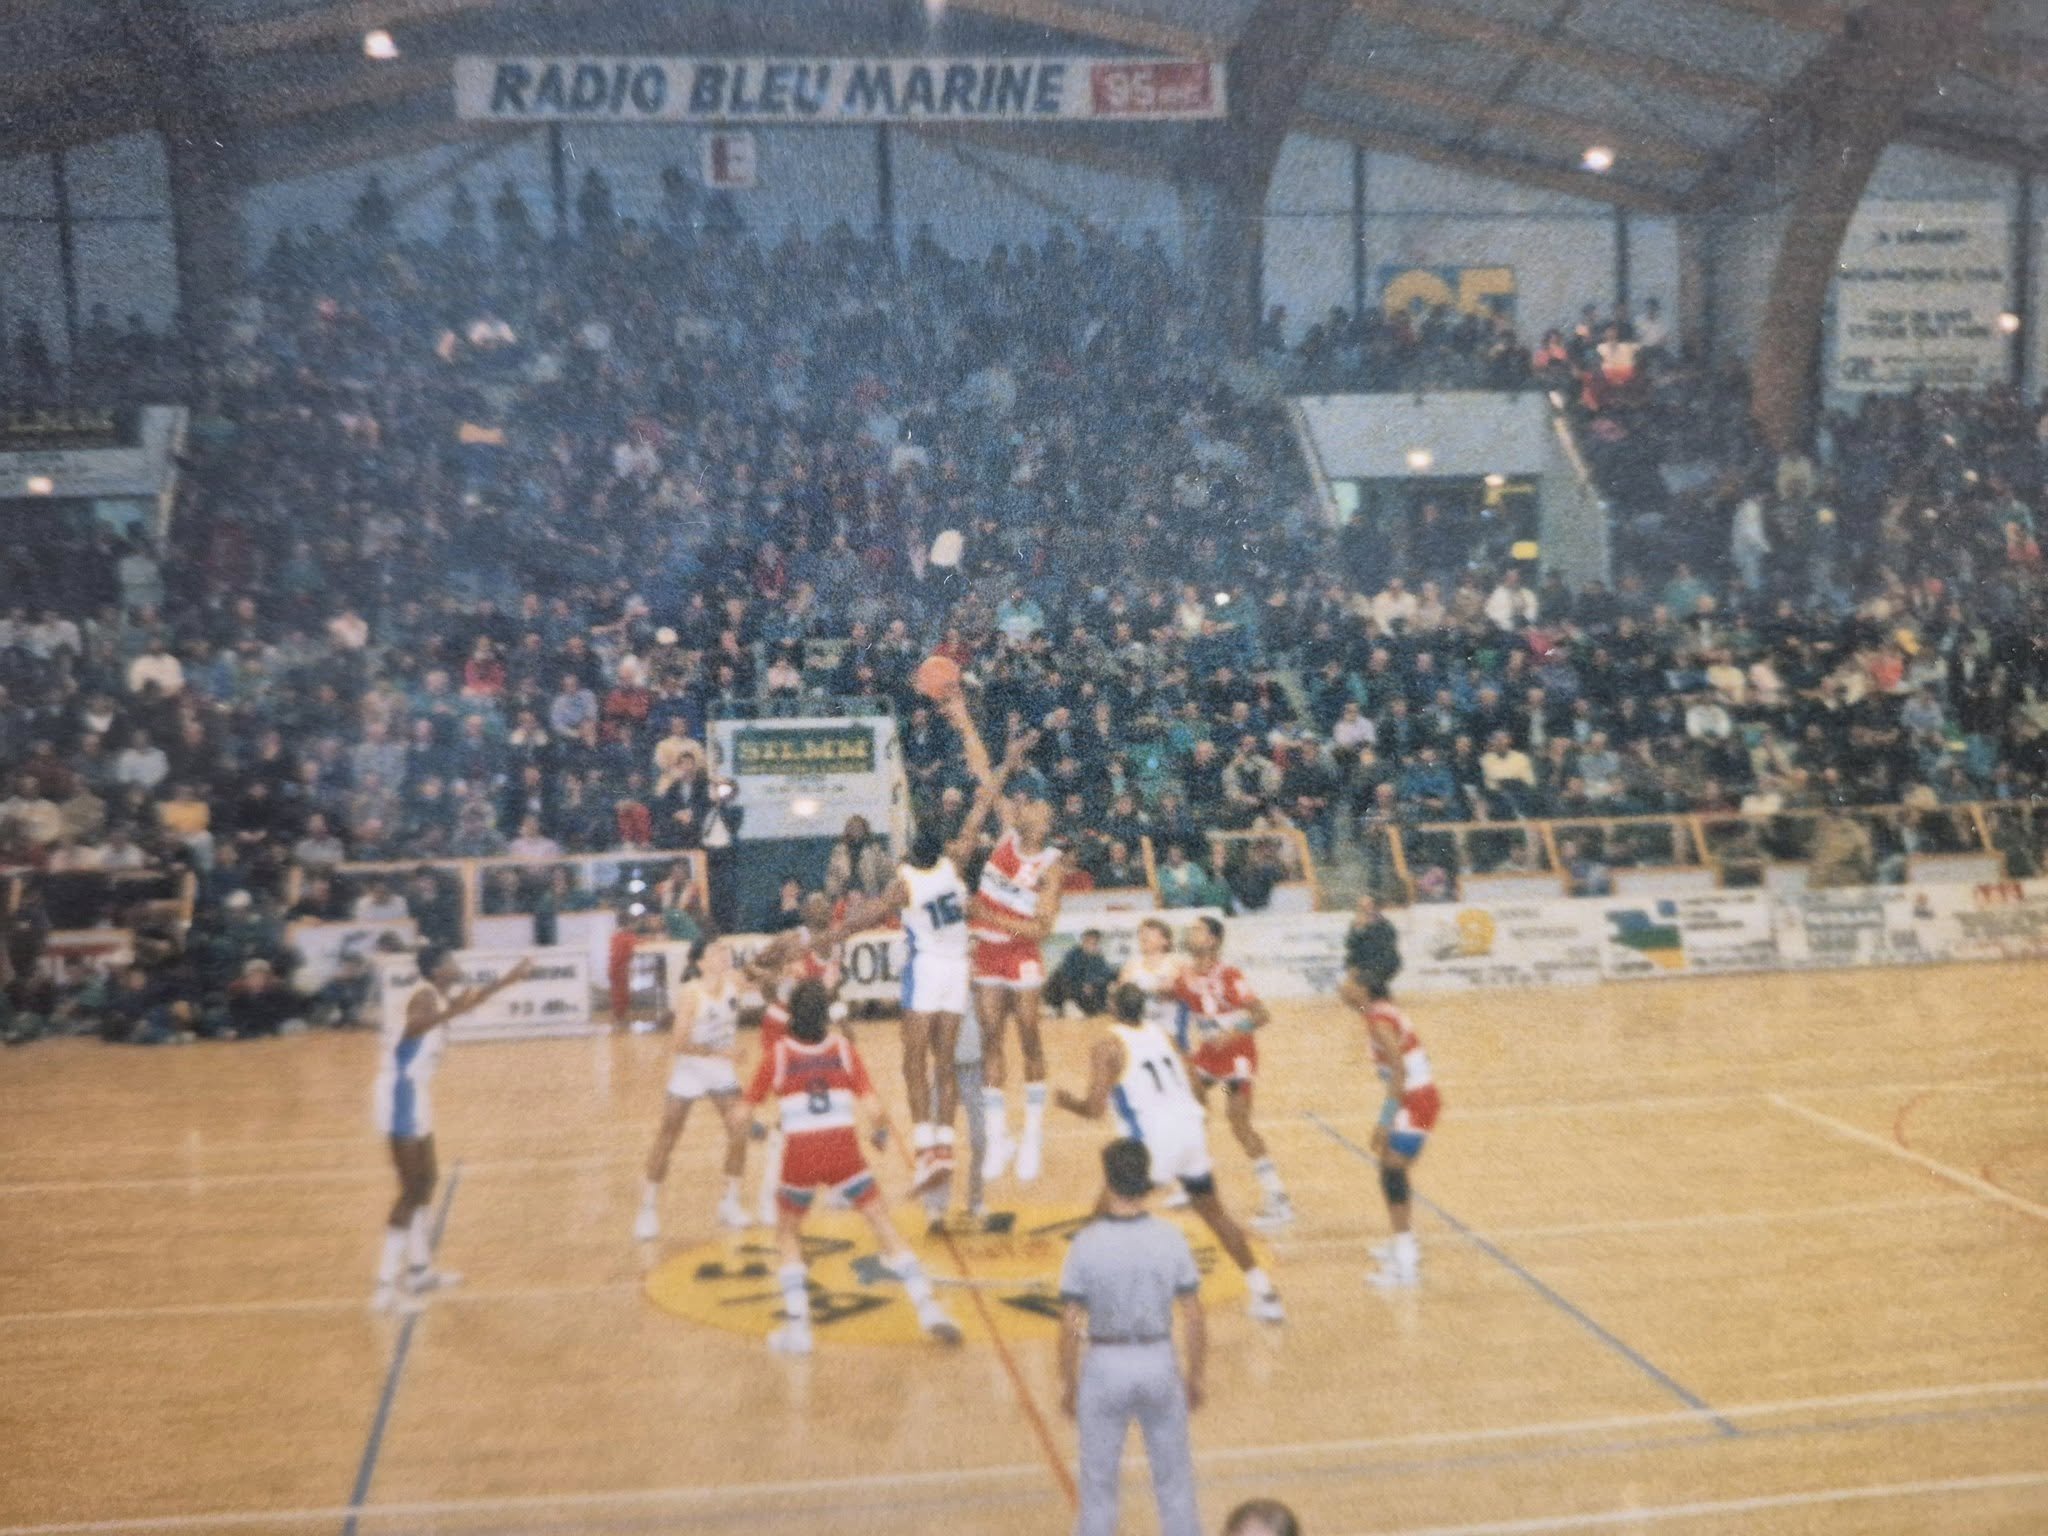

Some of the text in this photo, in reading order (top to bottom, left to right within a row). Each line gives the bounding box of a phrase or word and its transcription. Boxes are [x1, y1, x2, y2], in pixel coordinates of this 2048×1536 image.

[490, 63, 667, 113] RADIO
[690, 63, 831, 113] BLEU
[842, 63, 1068, 113] MARINE
[1141, 1056, 1178, 1092] 11
